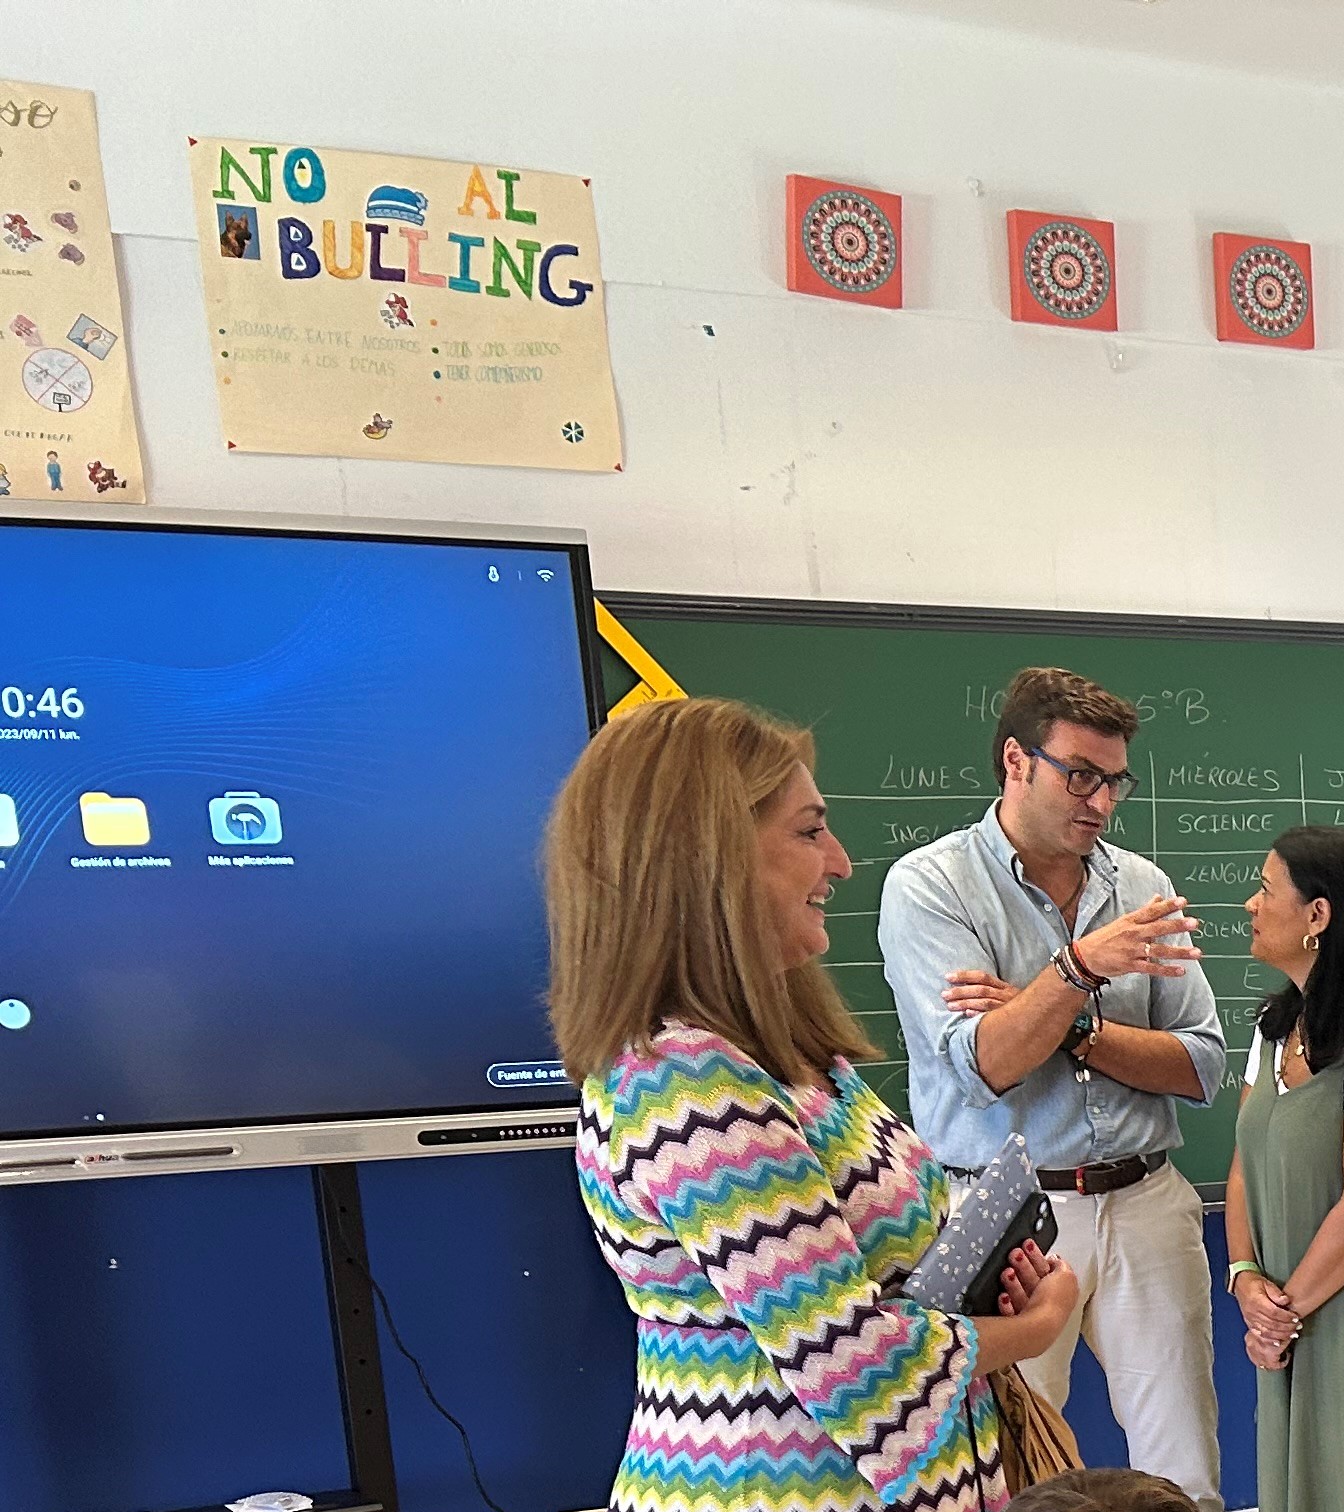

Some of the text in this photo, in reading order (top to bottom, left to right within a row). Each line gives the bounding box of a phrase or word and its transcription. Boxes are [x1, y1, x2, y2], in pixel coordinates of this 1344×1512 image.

[212, 146, 537, 225] NO AL
[278, 216, 593, 307] BULLING
[880, 754, 981, 790] LUNES
[1177, 812, 1274, 834] SCIENCE
[1185, 862, 1263, 883] LENGUA
[1192, 919, 1252, 938] SCIENC
[497, 1070, 533, 1081] Fuente
[534, 1069, 548, 1079] de
